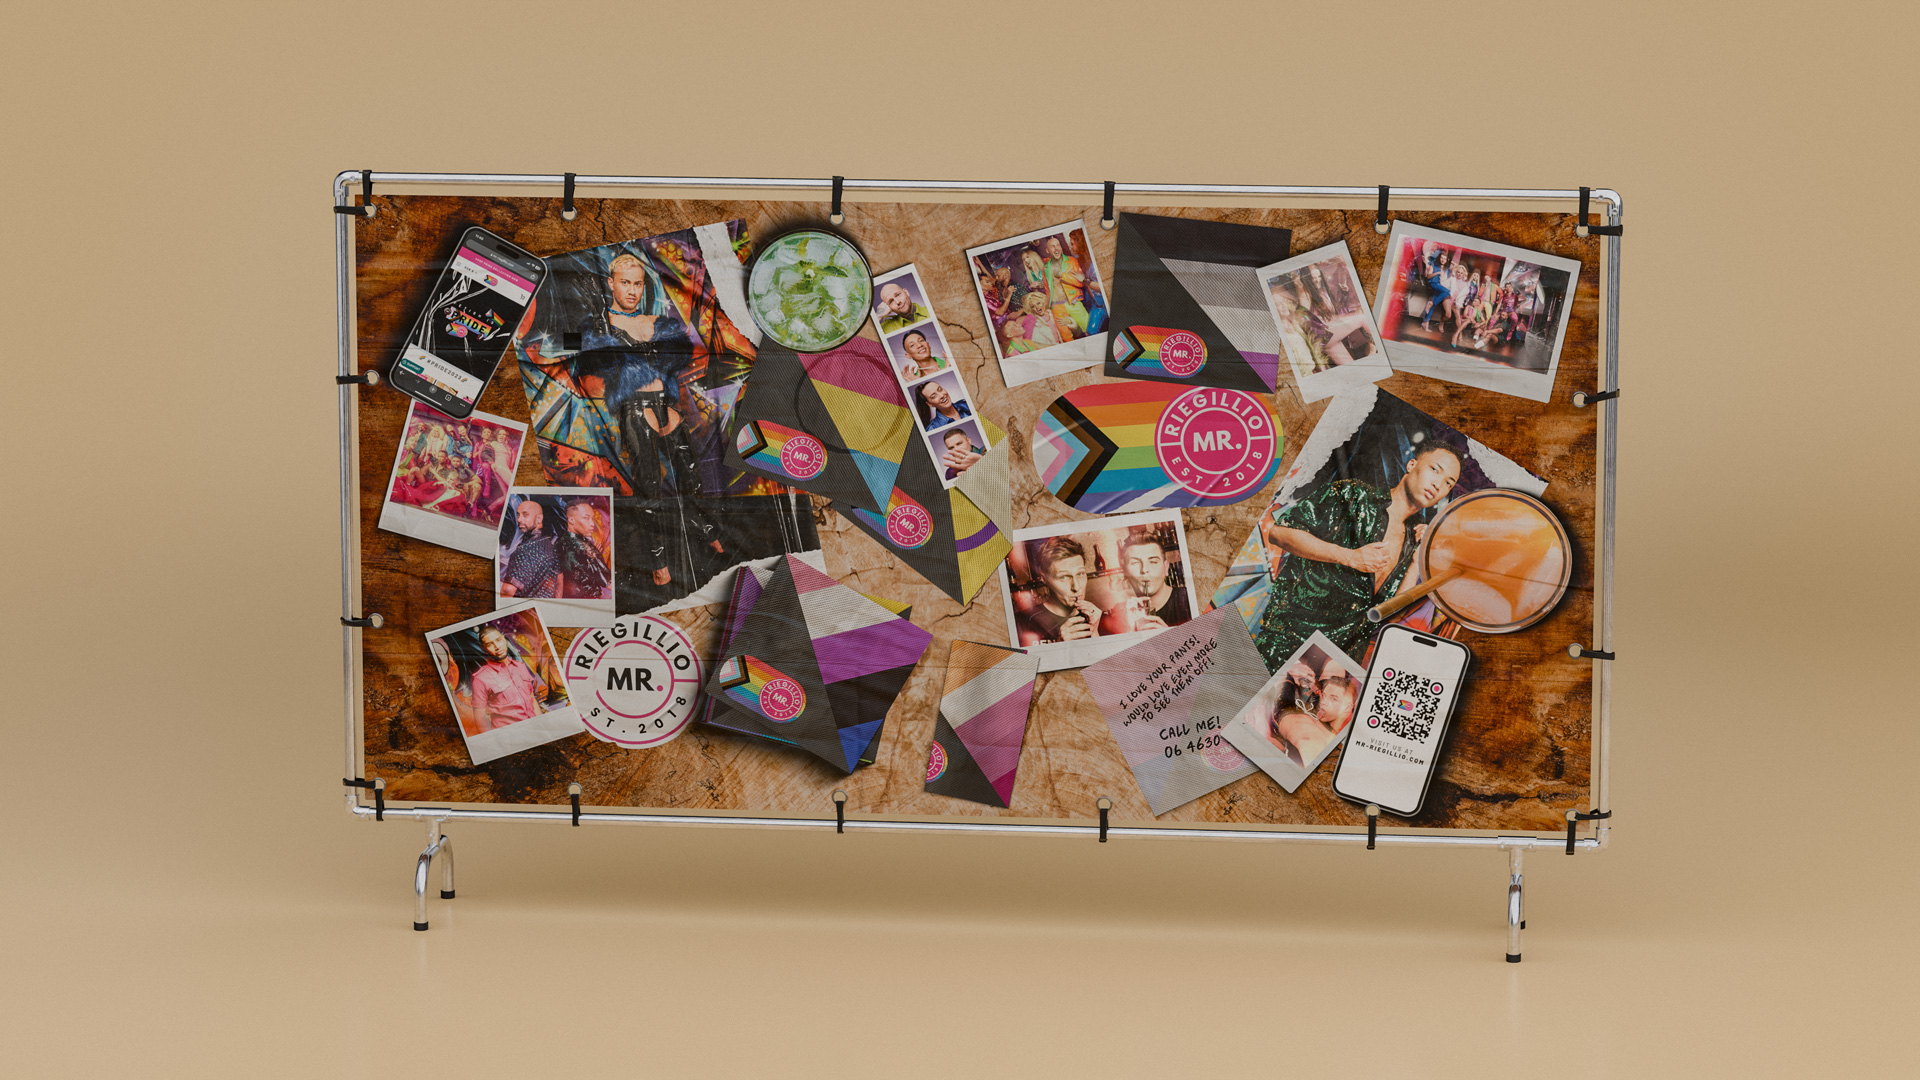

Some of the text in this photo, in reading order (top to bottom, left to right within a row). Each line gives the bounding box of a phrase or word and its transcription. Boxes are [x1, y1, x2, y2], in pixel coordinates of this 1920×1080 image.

[452, 311, 487, 333] PRIDE
[1163, 335, 1201, 353] RIEGILLIO
[1172, 349, 1191, 360] MR.
[426, 359, 462, 380] #PRIDE2023
[1164, 391, 1263, 437] RIEGILLIO
[786, 438, 822, 459] RIEGILLIO
[1193, 430, 1242, 452] MR.
[793, 450, 811, 463] MR.
[1171, 451, 1262, 488] EST. 2018
[896, 507, 927, 533] RIEGILLIO
[899, 517, 915, 534] MR.
[574, 621, 690, 671] RIEGILLIO
[606, 667, 664, 692] MR.
[1119, 634, 1200, 710] I LOVE YOUR PANTS!
[1123, 637, 1218, 727] WOULD LOVE EVEN MORE
[767, 681, 800, 705] RIEGILLIO
[772, 692, 789, 707] MR.
[1141, 656, 1215, 723] TO SEE THEM OFF!
[590, 696, 687, 734] ST. 2018
[1159, 715, 1222, 740] CALL ME!
[1164, 734, 1221, 758] 06 4630
[1355, 740, 1424, 766] MR-RIEGILLIO.COM
[1370, 738, 1390, 748] VISIT
[1392, 744, 1402, 752] US
